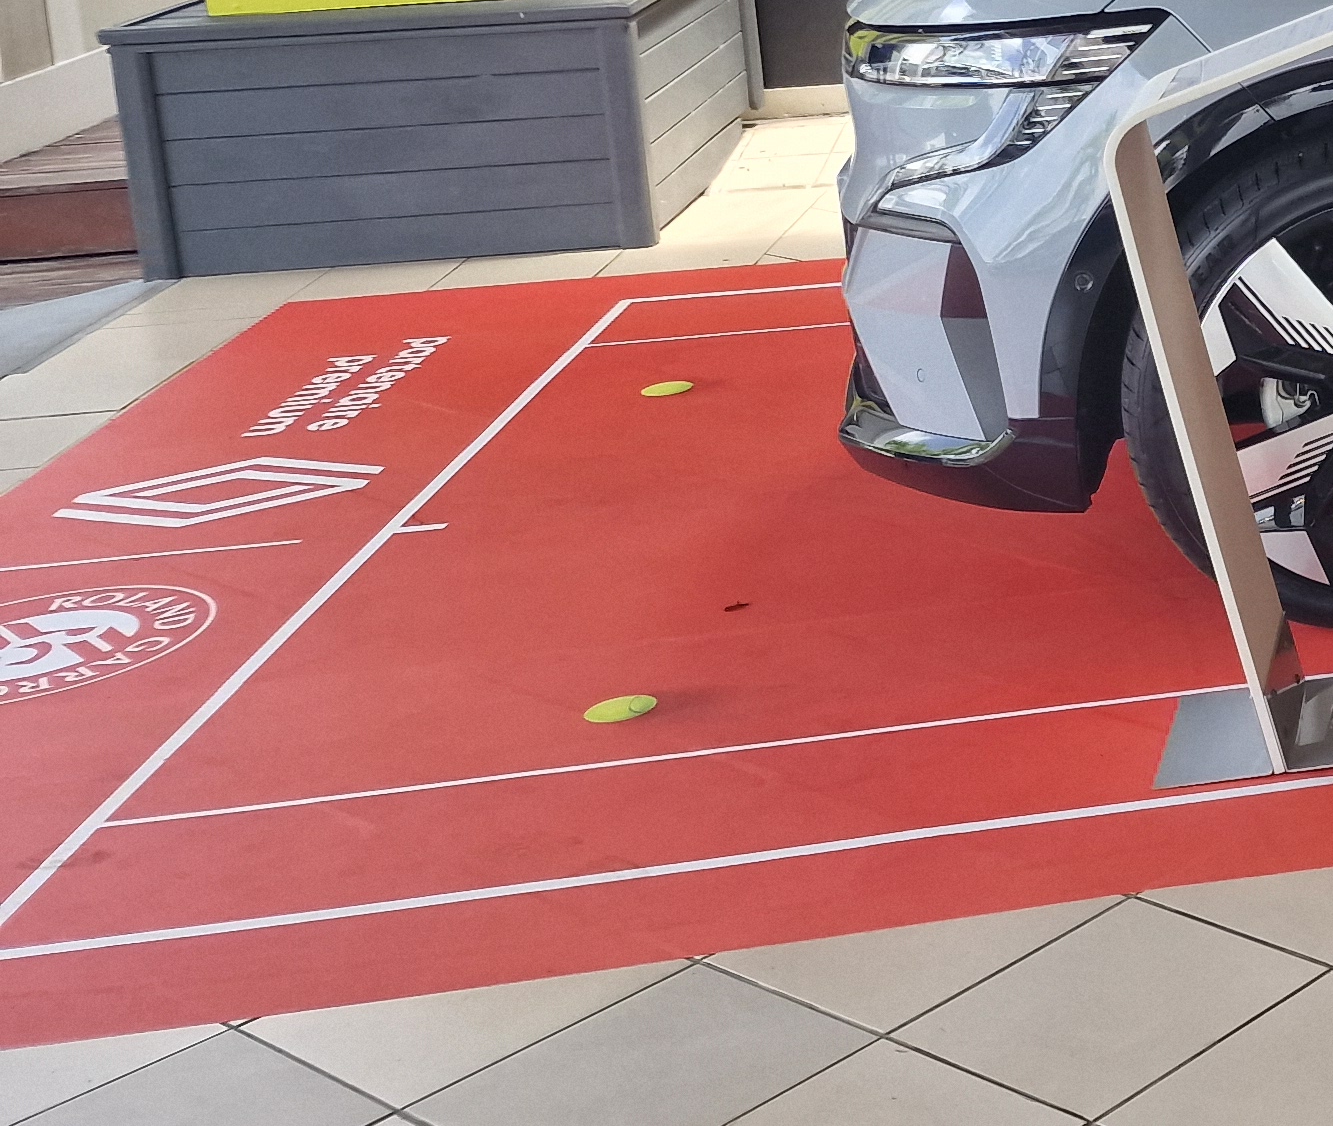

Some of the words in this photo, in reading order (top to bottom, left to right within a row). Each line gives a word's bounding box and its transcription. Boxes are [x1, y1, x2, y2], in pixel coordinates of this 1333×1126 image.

[241, 354, 378, 437] premium
[307, 335, 452, 431] partenaire
[48, 591, 196, 630] ROLAND
